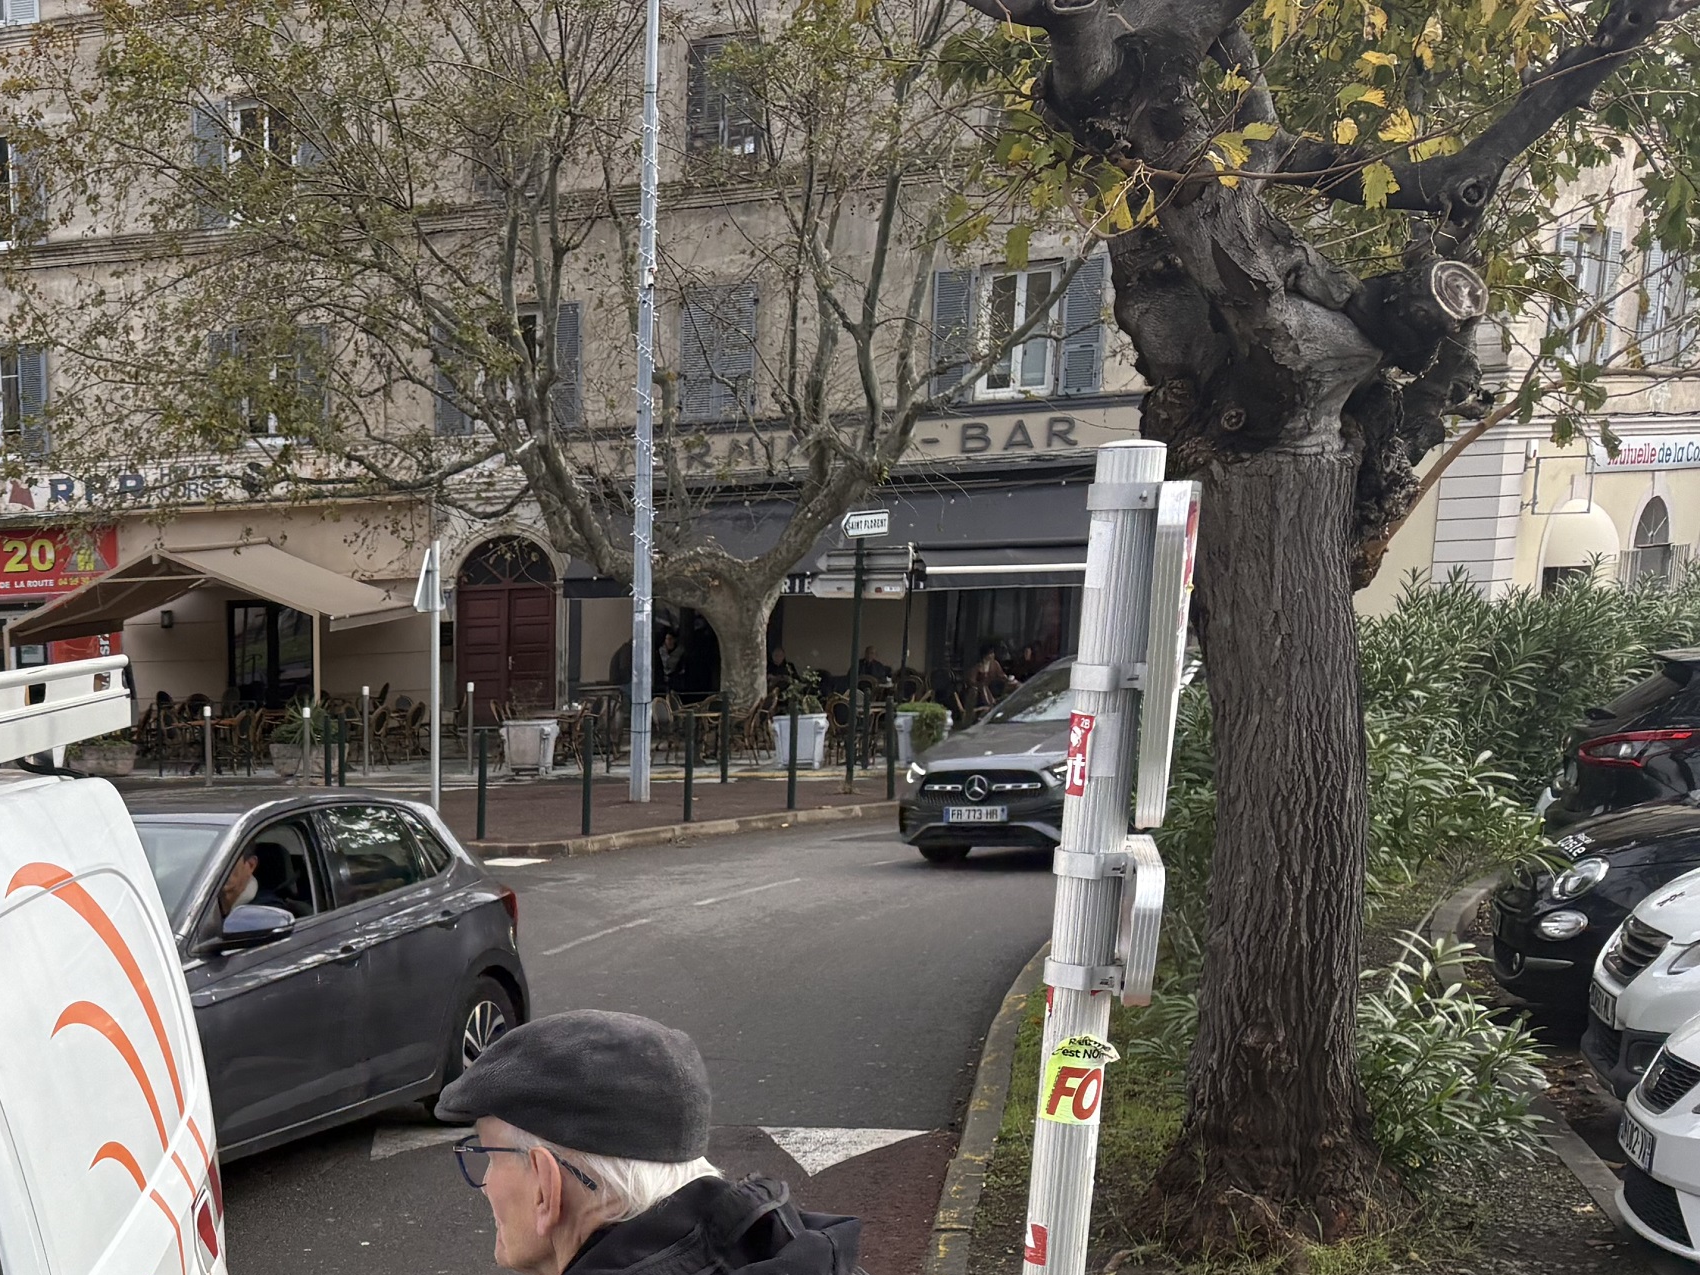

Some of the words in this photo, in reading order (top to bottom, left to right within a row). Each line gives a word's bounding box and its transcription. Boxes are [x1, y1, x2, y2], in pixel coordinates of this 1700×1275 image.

[960, 416, 1078, 453] BAR
[1658, 443, 1671, 463] de
[1673, 443, 1685, 463] la
[4, 538, 55, 573] 20
[0, 581, 10, 589] DE
[14, 580, 25, 588] LA
[27, 579, 54, 588] ROUTE
[964, 808, 982, 820] 773
[1046, 1066, 1102, 1121] FO
